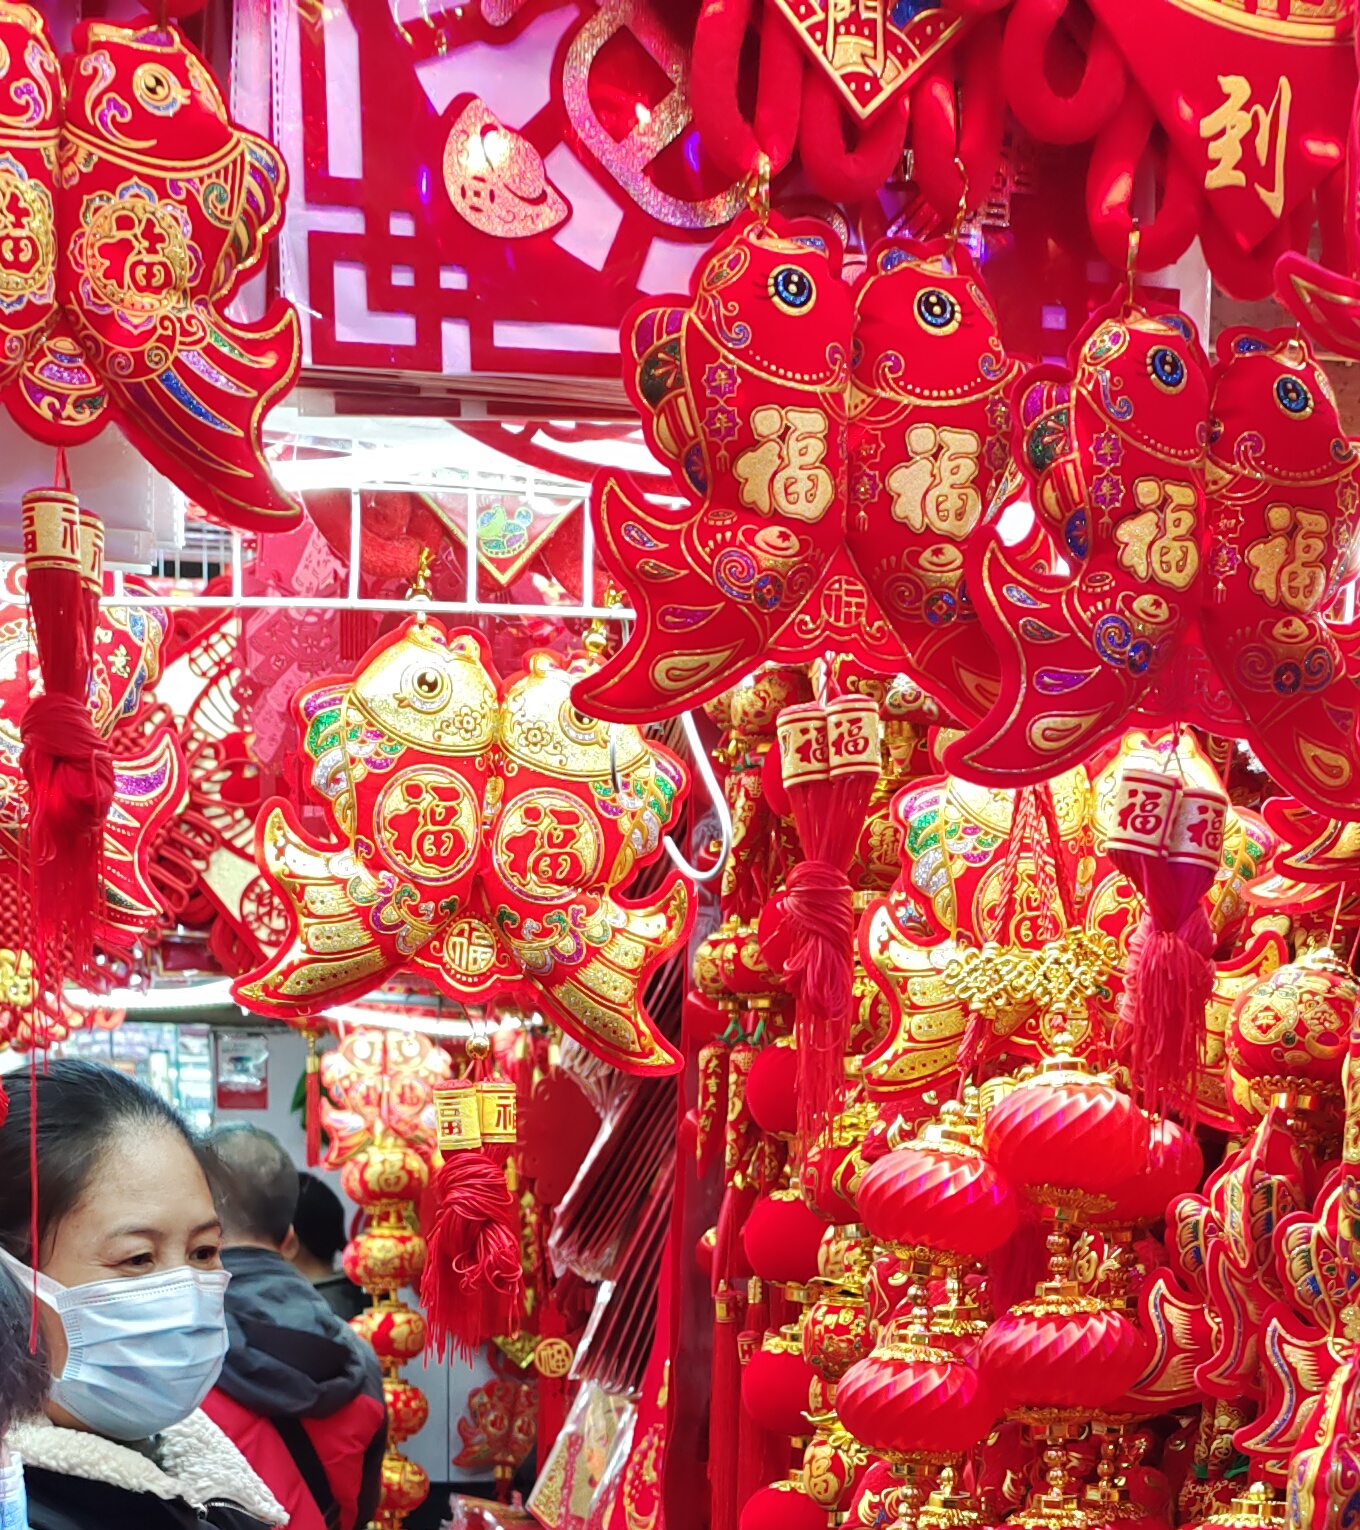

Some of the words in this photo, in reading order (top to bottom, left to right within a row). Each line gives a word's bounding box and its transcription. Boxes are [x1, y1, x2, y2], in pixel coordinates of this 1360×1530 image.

[1199, 75, 1292, 218] 到
[97, 213, 175, 294] 福
[710, 368, 734, 434] 年年
[733, 405, 835, 523] 福
[885, 423, 981, 541] 福
[1114, 476, 1199, 592] 福
[1245, 503, 1327, 614] 福
[795, 726, 829, 764] 福
[830, 717, 870, 757] 福
[384, 781, 468, 870] 福
[502, 803, 586, 889] 福
[1116, 790, 1163, 836] 福
[1187, 806, 1226, 851] 福
[445, 920, 496, 974] 福
[699, 1056, 722, 1132] 大吉大利
[538, 1341, 571, 1376] 福
